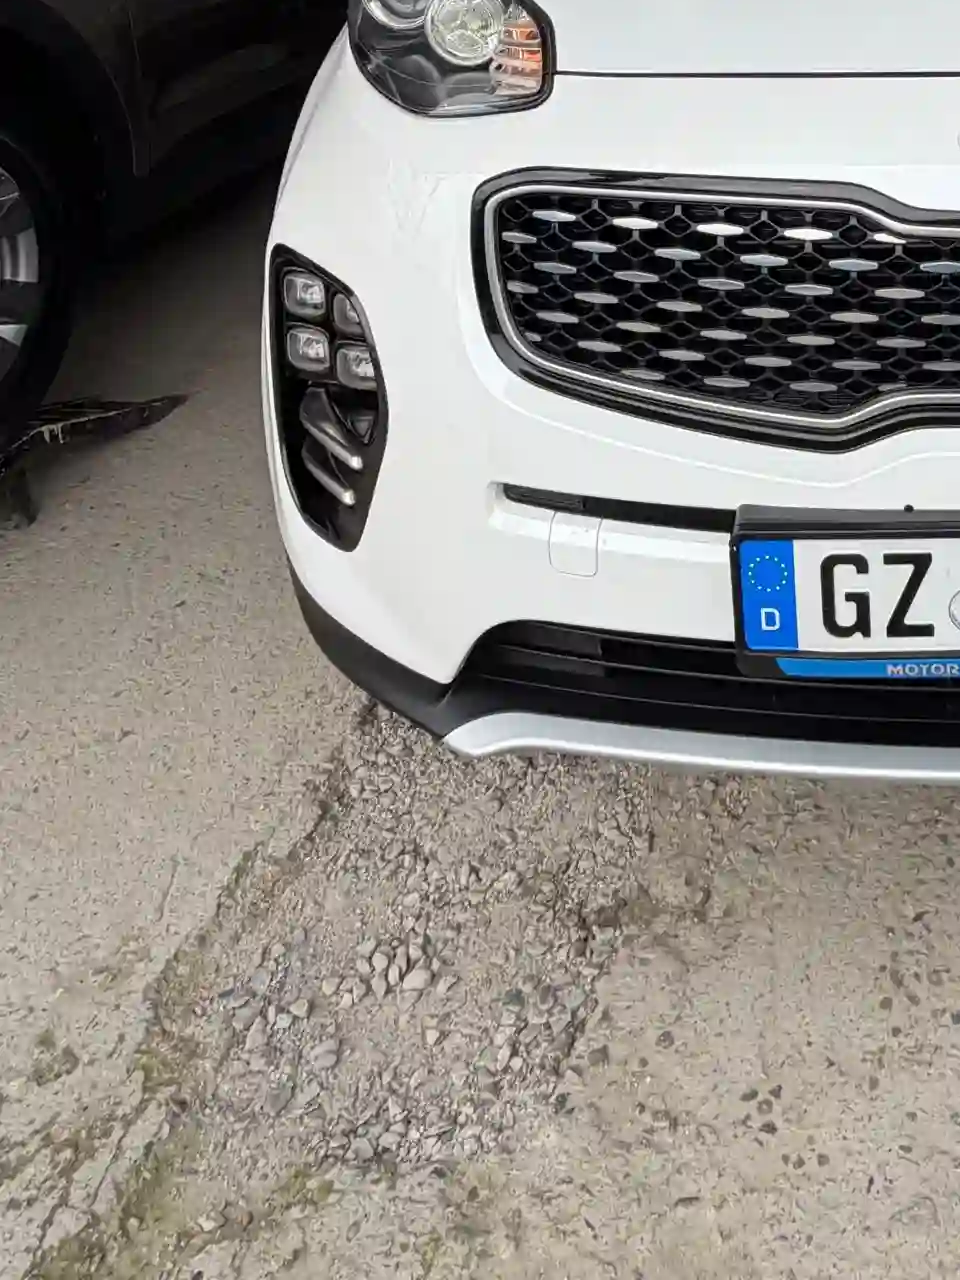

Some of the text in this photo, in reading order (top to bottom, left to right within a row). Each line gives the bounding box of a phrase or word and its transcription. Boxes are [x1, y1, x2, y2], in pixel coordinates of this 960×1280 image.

[820, 552, 935, 638] GZ
[761, 608, 780, 631] D
[886, 663, 960, 676] MOTOR
